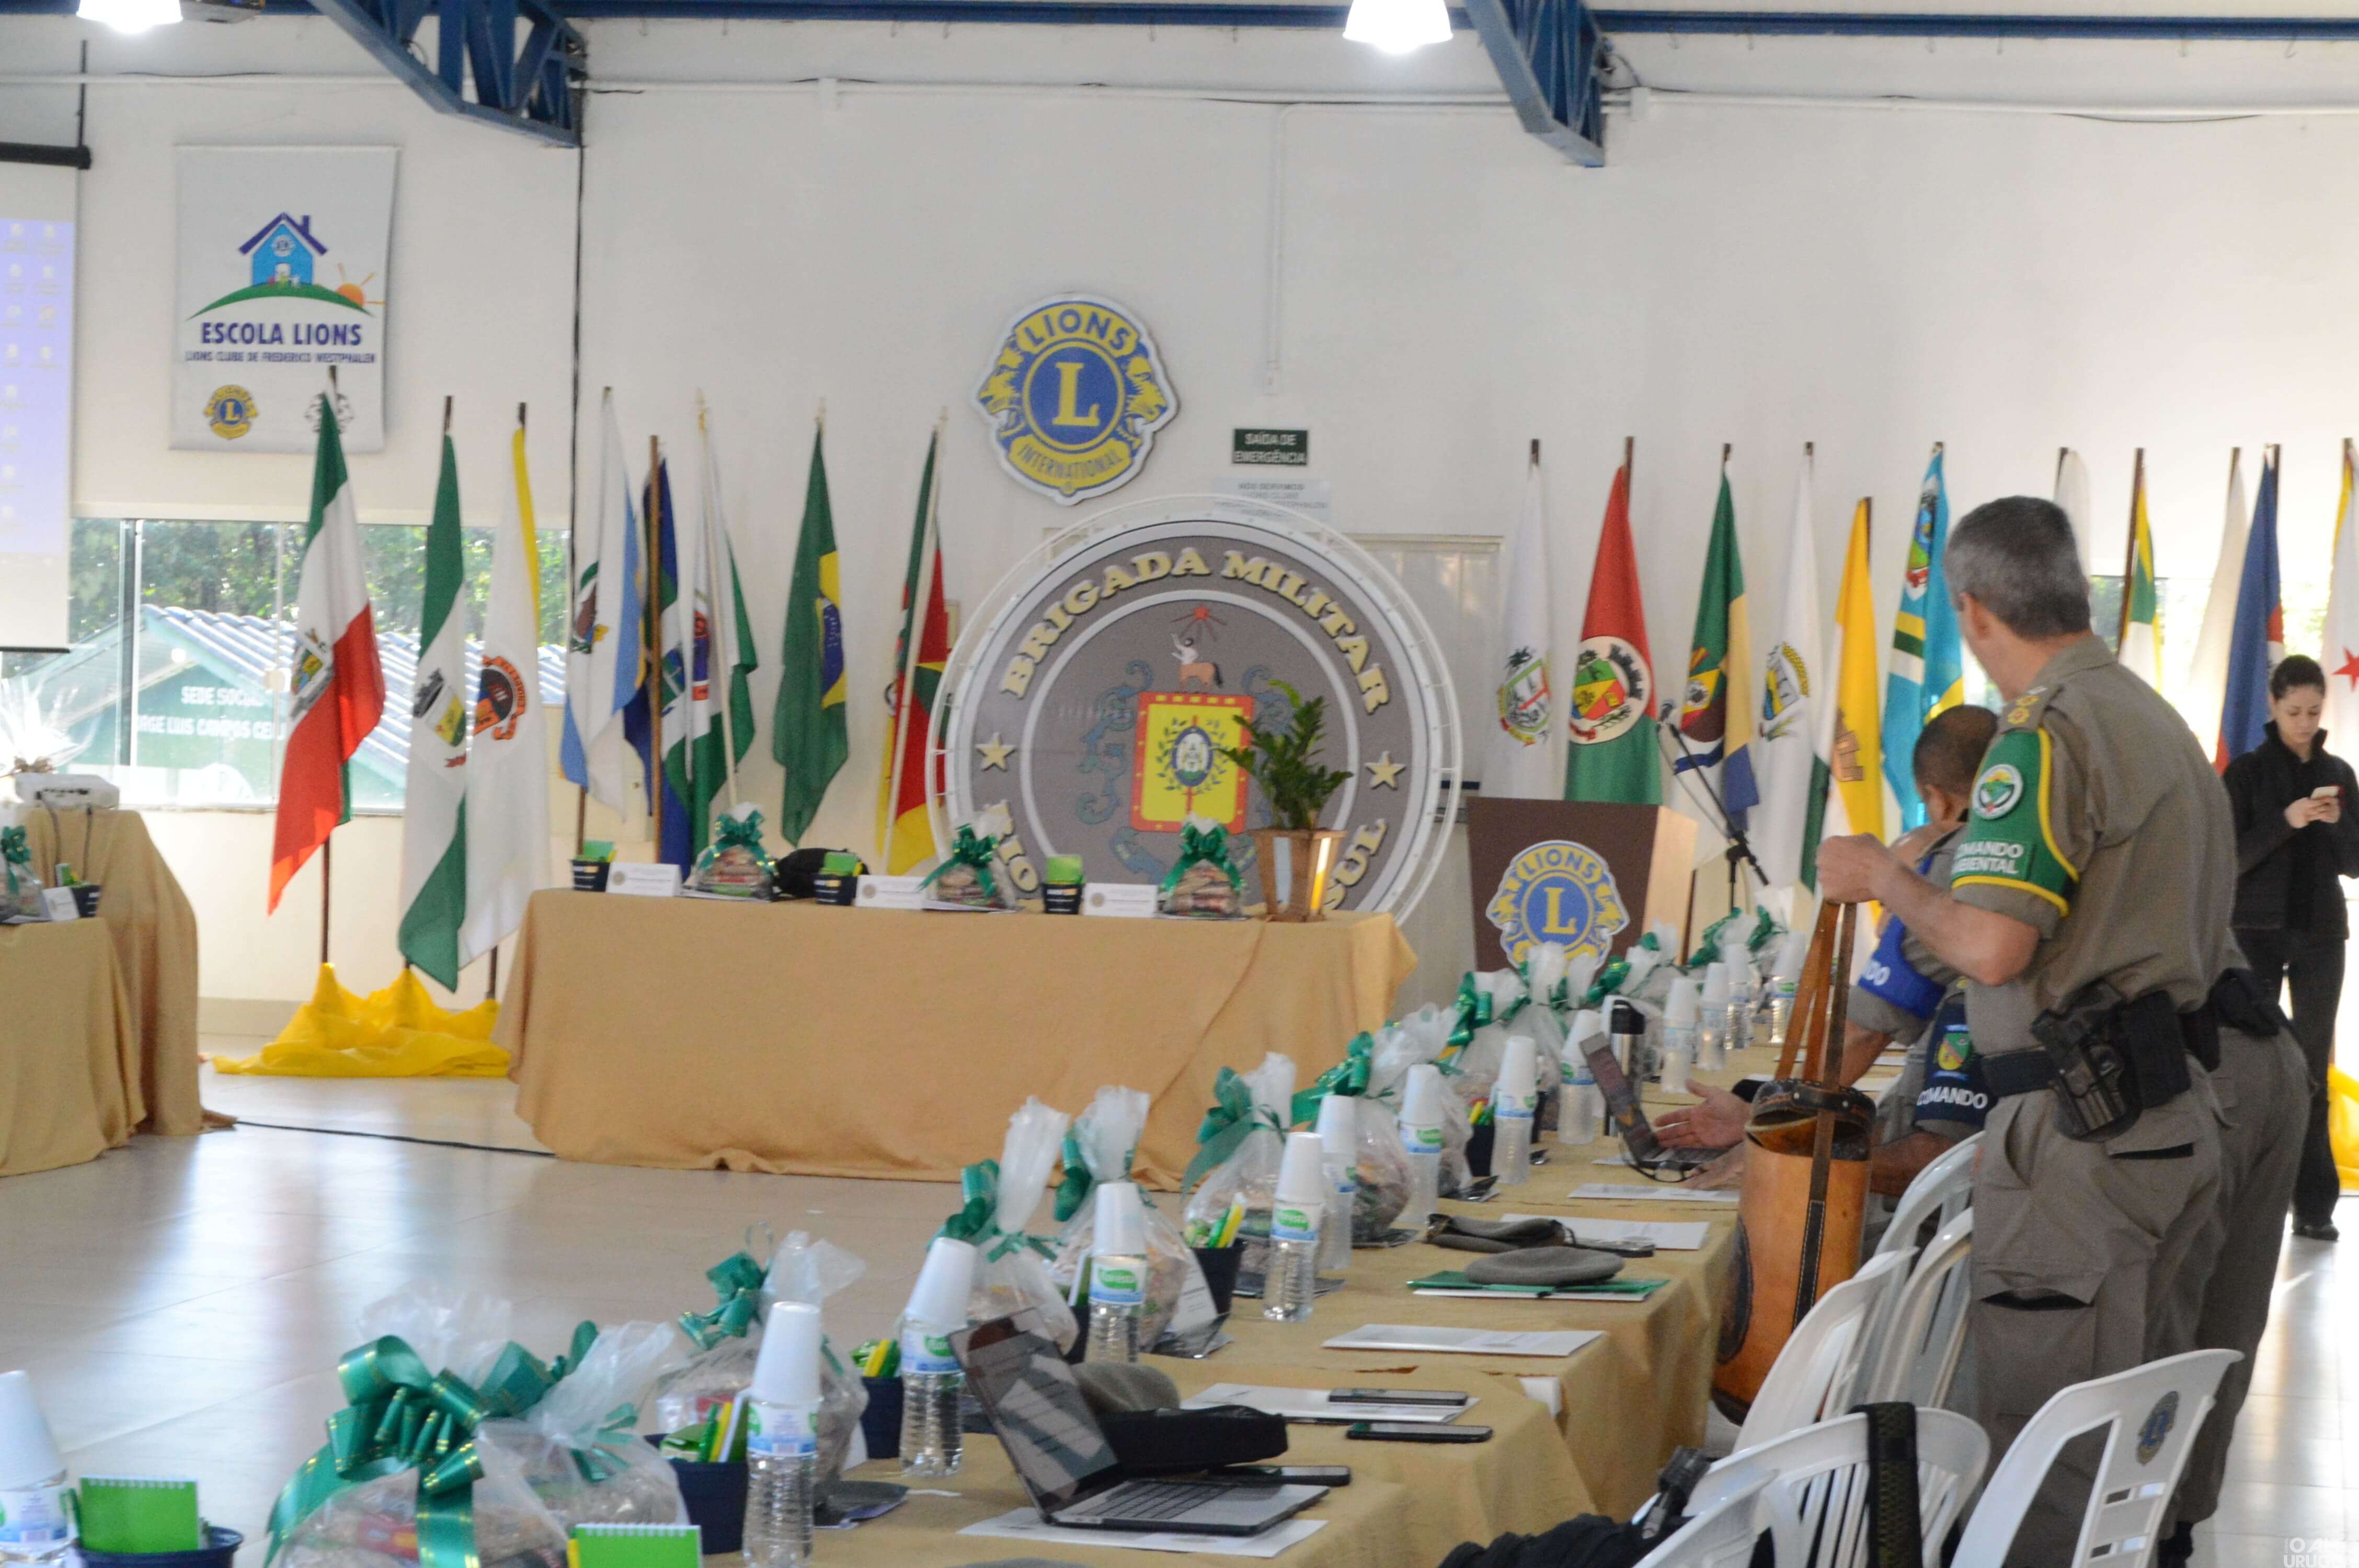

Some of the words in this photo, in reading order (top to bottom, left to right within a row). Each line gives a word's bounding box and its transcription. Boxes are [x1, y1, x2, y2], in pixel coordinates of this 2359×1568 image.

[201, 322, 284, 344] ESCOLA
[293, 323, 362, 345] LIONS
[1024, 309, 1131, 351] LIONS
[1052, 362, 1101, 427] L
[1018, 444, 1123, 479] INTERNATIONAL
[1000, 547, 1211, 699] BRIGADA
[1221, 550, 1390, 715] MILITAR
[181, 686, 215, 705] SEDE
[1522, 849, 1597, 879] LIONS
[1543, 887, 1577, 935] L
[1916, 1086, 1988, 1109] COMANDO
